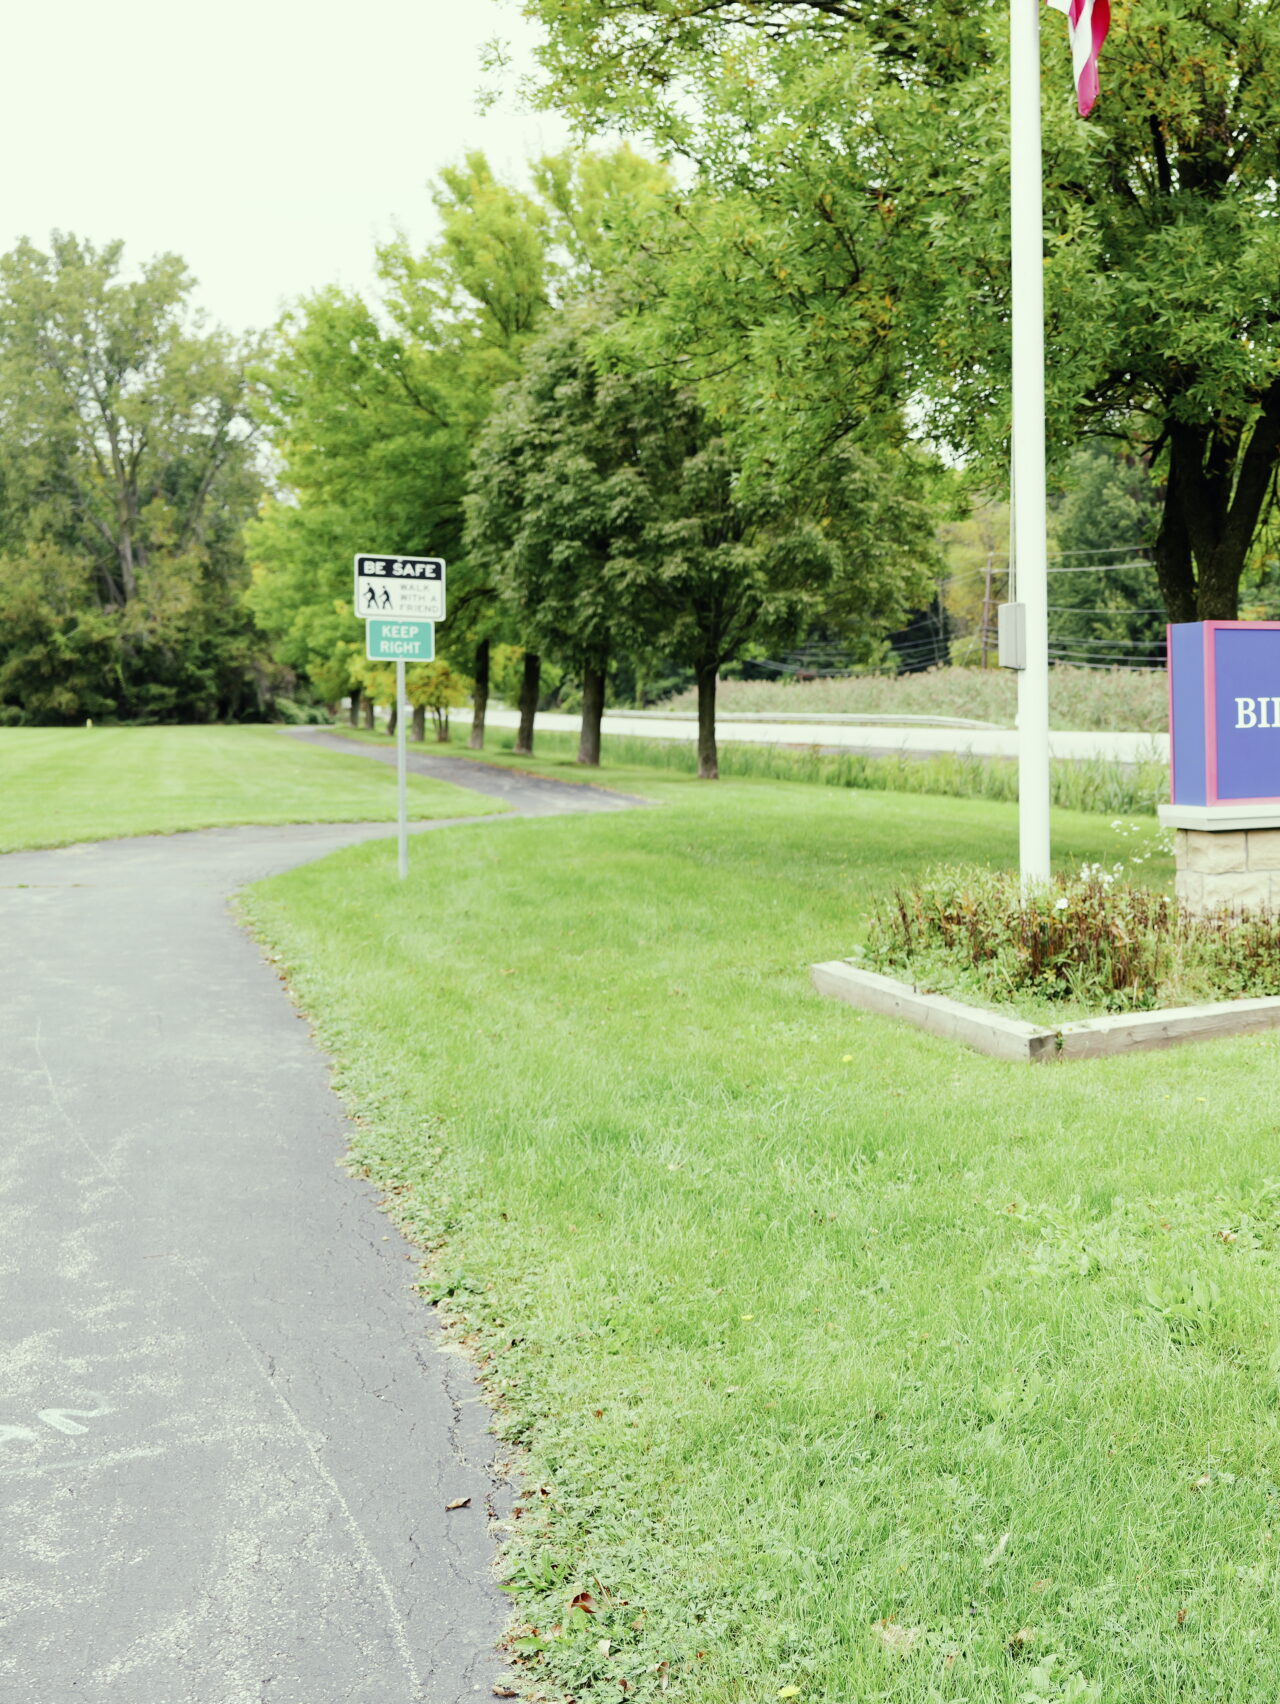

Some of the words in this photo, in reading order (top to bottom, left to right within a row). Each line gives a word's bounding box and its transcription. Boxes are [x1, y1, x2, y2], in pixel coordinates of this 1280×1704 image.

[364, 561, 386, 575] BE
[392, 562, 436, 577] SAFE
[400, 604, 439, 613] FRIEND
[381, 624, 418, 638] KEEP
[380, 640, 421, 654] RIGHT
